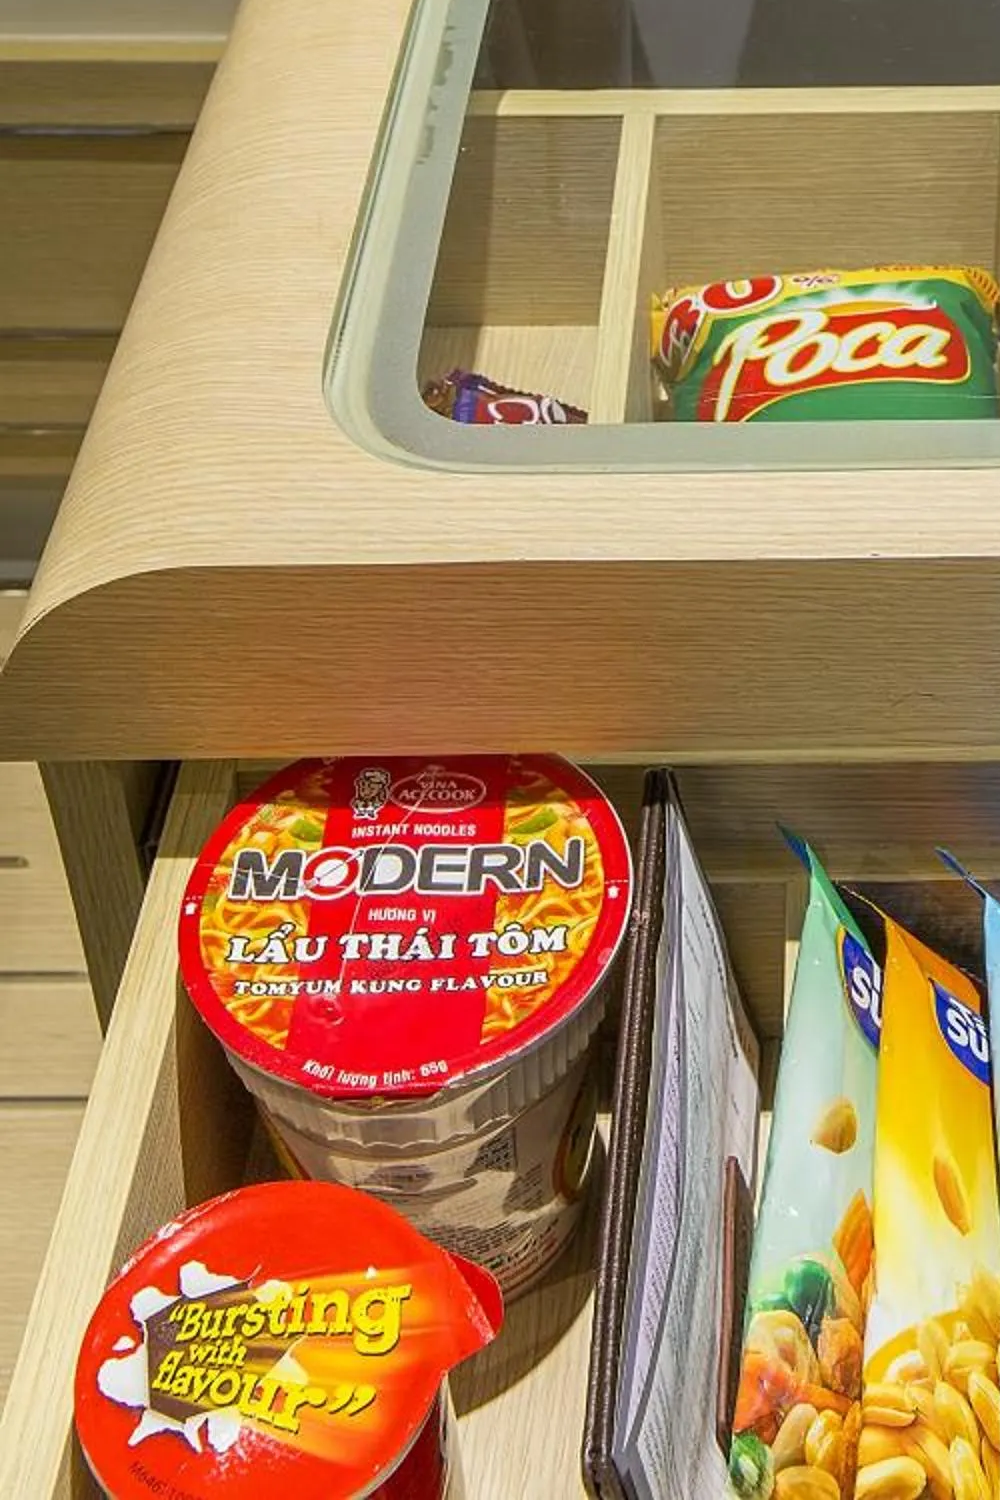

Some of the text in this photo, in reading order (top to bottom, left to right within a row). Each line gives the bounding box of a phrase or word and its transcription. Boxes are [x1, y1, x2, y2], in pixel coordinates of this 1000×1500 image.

[714, 308, 953, 422] Poca
[419, 779, 458, 789] VINA
[351, 822, 477, 839] INSTANT NOODLES
[228, 836, 585, 901] MODERN
[226, 921, 568, 964] LẨU THÁI TÔM
[234, 970, 549, 997] TOMYUM KUNG FLAVOUR
[188, 1336, 248, 1367] with
